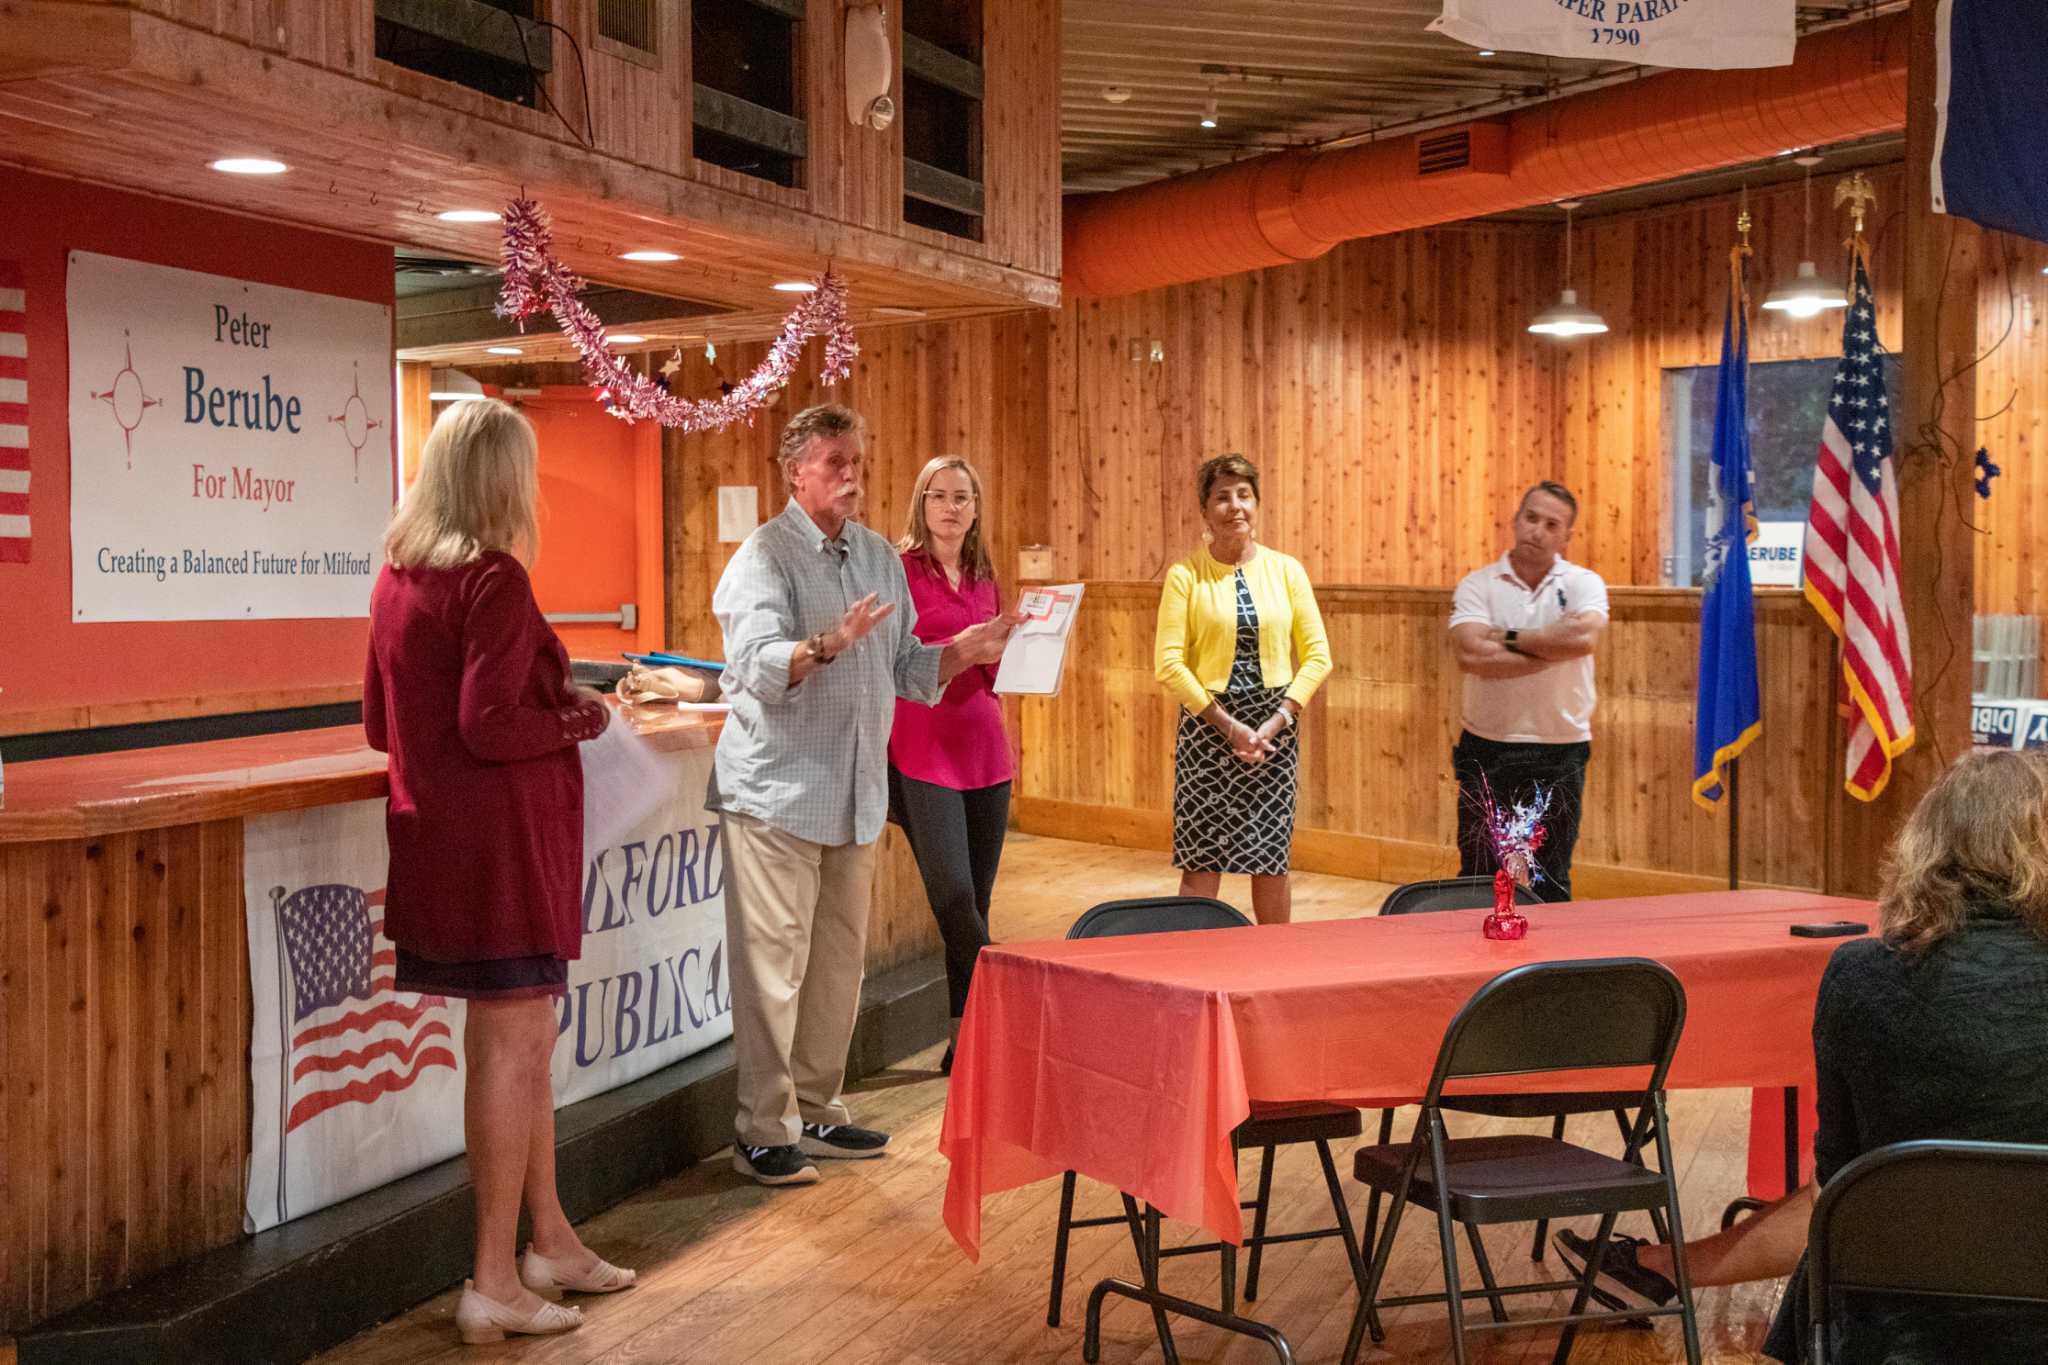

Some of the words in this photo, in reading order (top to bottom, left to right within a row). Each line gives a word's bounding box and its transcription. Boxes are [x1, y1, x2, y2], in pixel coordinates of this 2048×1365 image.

[1592, 28, 1640, 46] 1790
[214, 304, 272, 349] Peter
[182, 366, 301, 434] Berube
[192, 463, 226, 499] For
[232, 467, 295, 512] Mayor
[98, 547, 166, 582] Creating
[170, 558, 179, 574] a
[183, 549, 248, 576] Balanced
[252, 551, 298, 576] Future
[300, 552, 321, 576] for
[323, 551, 371, 576] Milford
[1751, 546, 1797, 561] ERUBE
[582, 824, 724, 934] ILFORD
